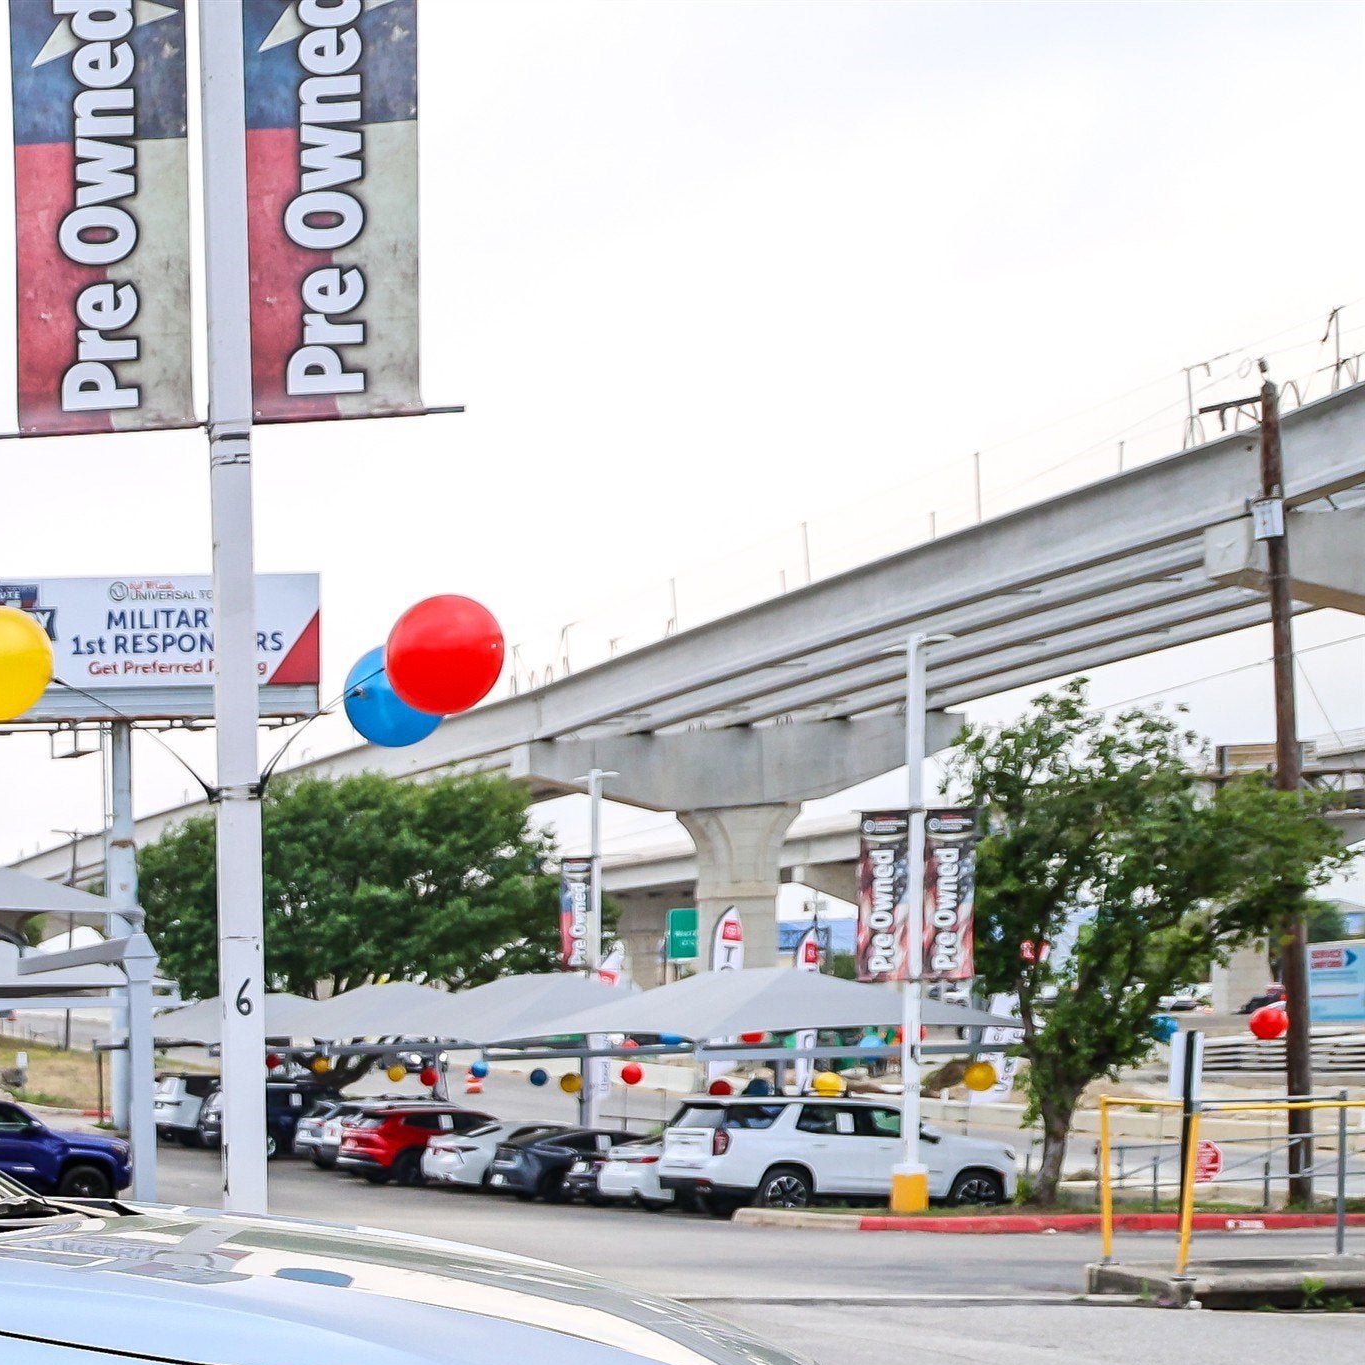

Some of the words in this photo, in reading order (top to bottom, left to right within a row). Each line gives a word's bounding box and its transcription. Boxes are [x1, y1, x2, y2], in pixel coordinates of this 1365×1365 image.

[53, 0, 138, 265] Owned
[62, 283, 138, 411] Pre
[287, 268, 365, 395] Pre
[131, 589, 197, 600] UNIVERSAL
[107, 607, 213, 629] MILITAR
[72, 634, 106, 655] 1st
[114, 631, 284, 653] RESPONRS
[88, 661, 118, 675] Get
[124, 658, 203, 674] Preferred
[869, 850, 895, 930] Owned
[933, 848, 960, 929] Owned
[868, 932, 895, 972] Pre
[931, 930, 959, 971] Pre
[236, 976, 254, 1016] 6
